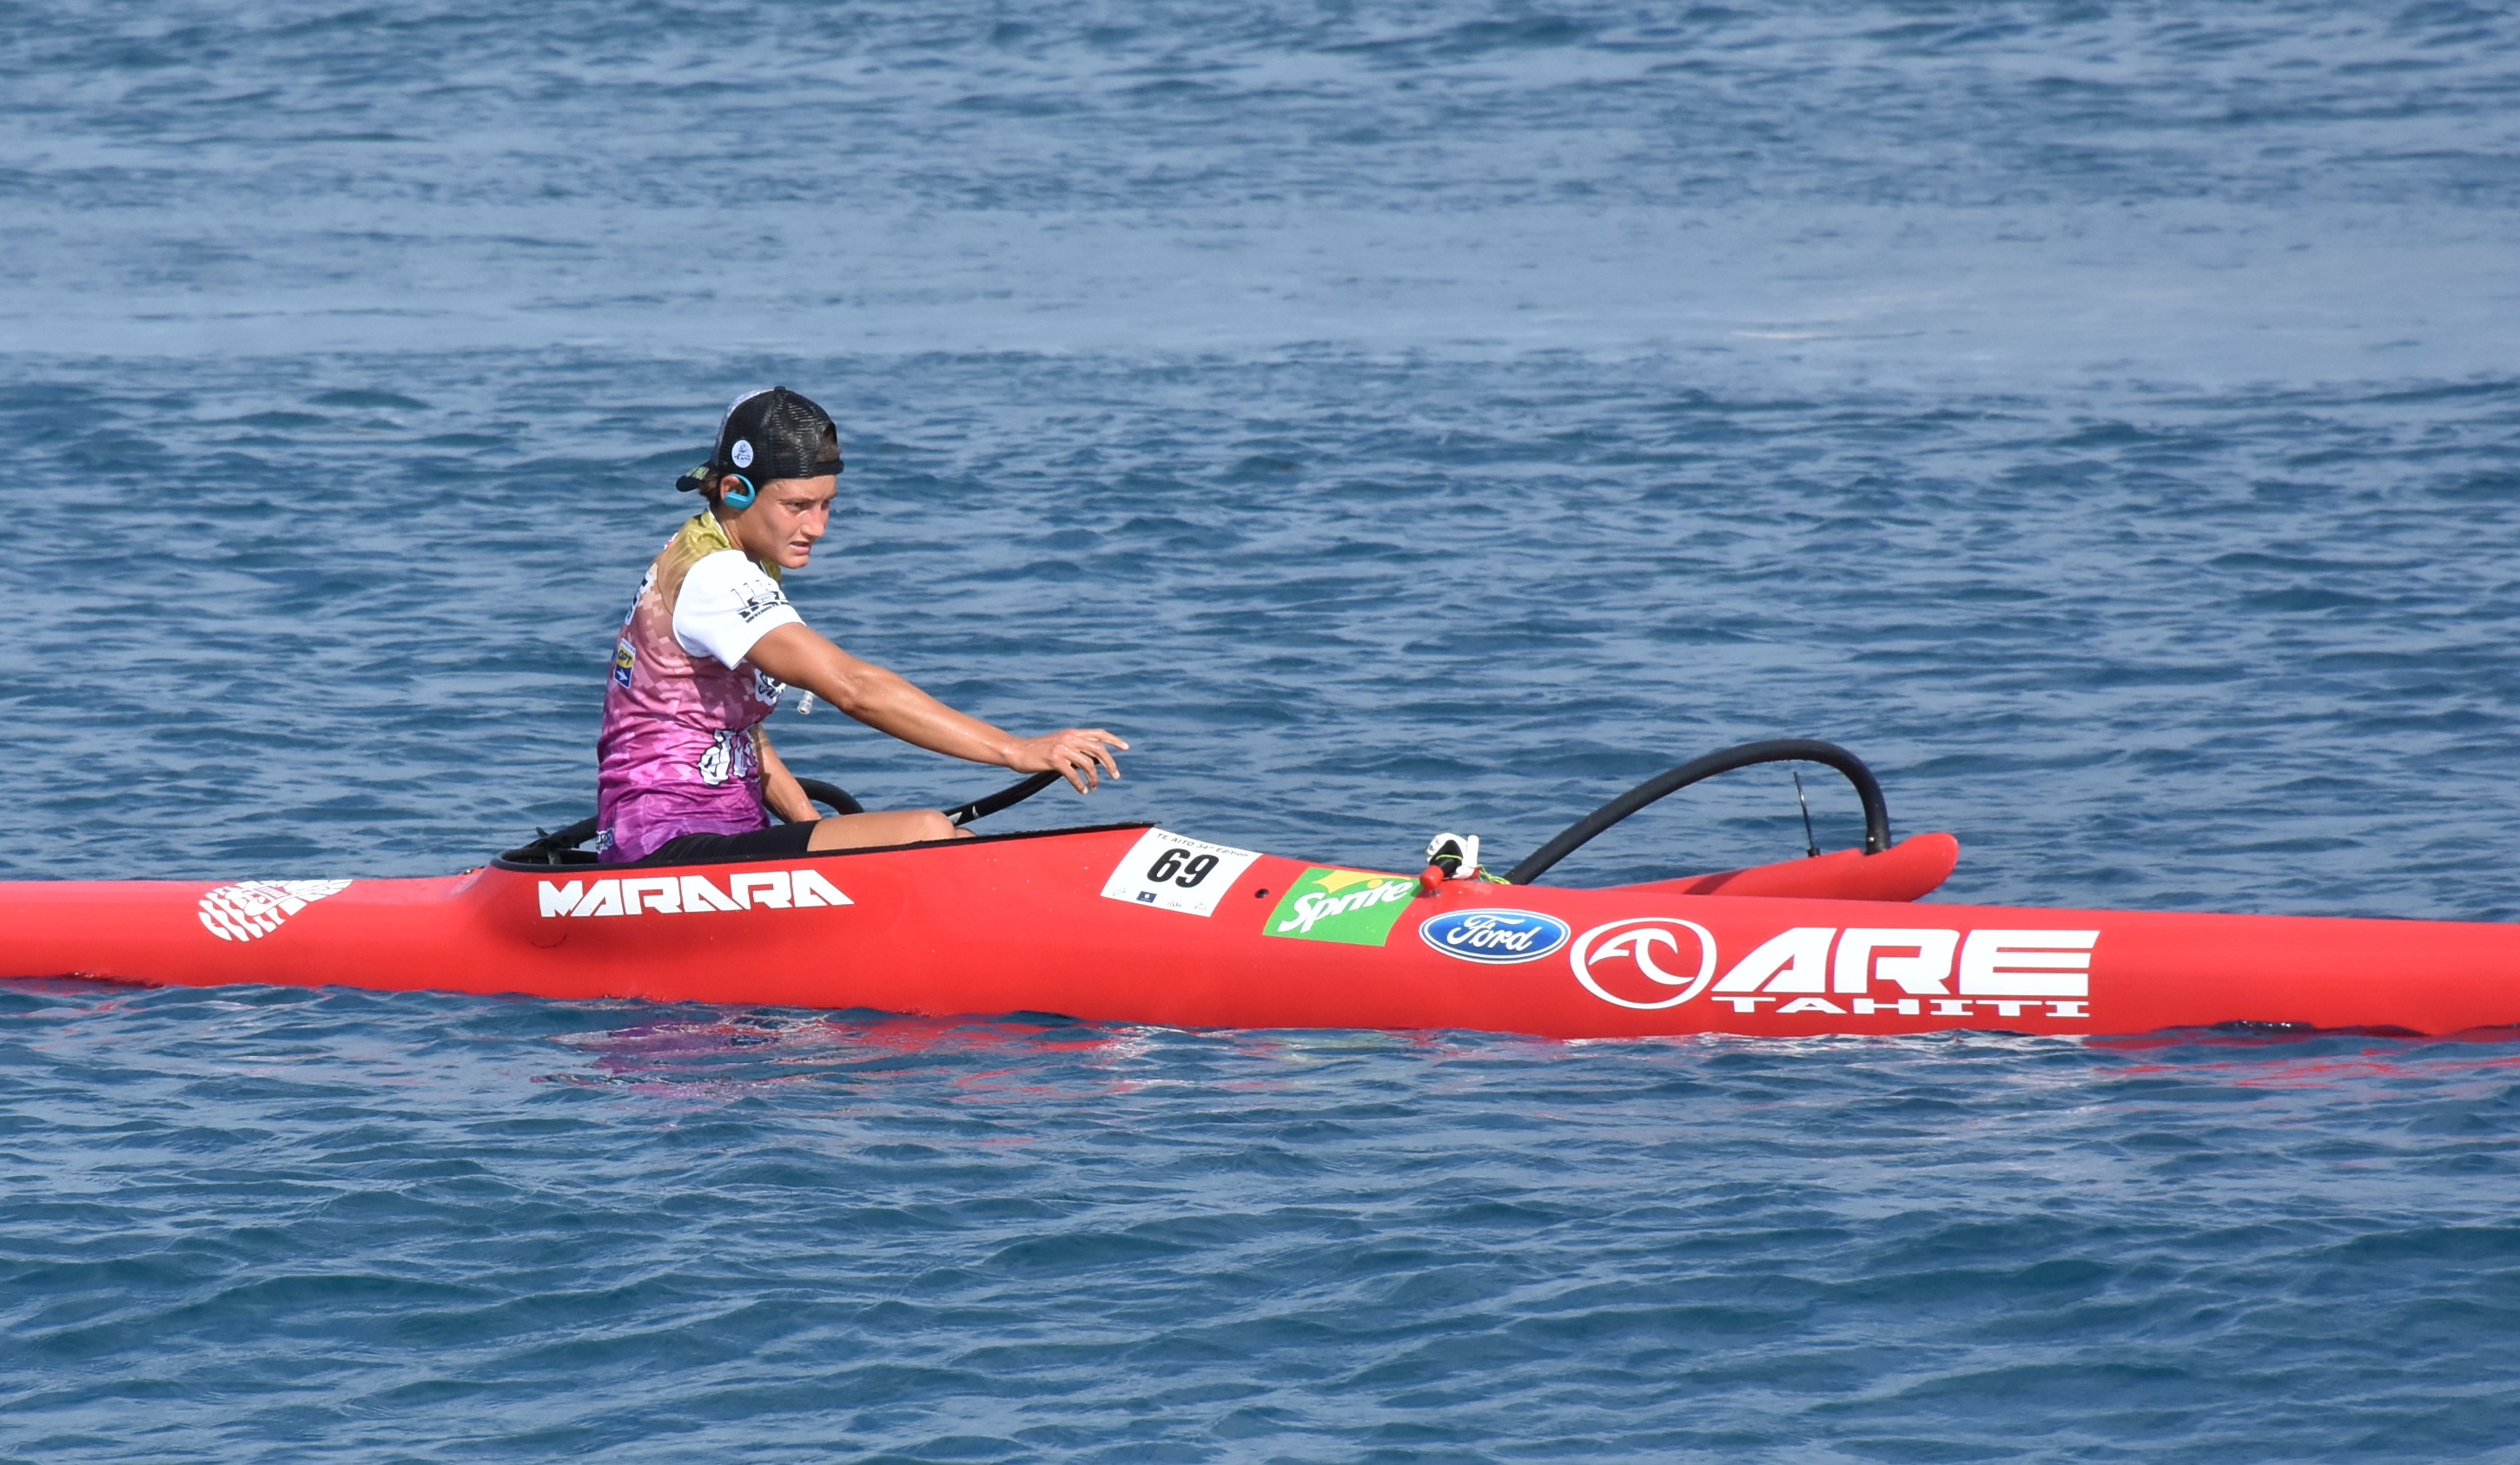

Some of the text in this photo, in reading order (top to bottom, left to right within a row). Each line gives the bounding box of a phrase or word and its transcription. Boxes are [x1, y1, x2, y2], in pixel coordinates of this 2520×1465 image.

[1171, 837, 1195, 847] AITO
[1147, 848, 1220, 888] 69
[538, 869, 855, 918] MARARA
[1277, 879, 1413, 934] Sprite
[1446, 914, 1543, 952] Ford
[1710, 927, 2100, 997] ARE
[1710, 996, 2090, 1018] TAHITI
